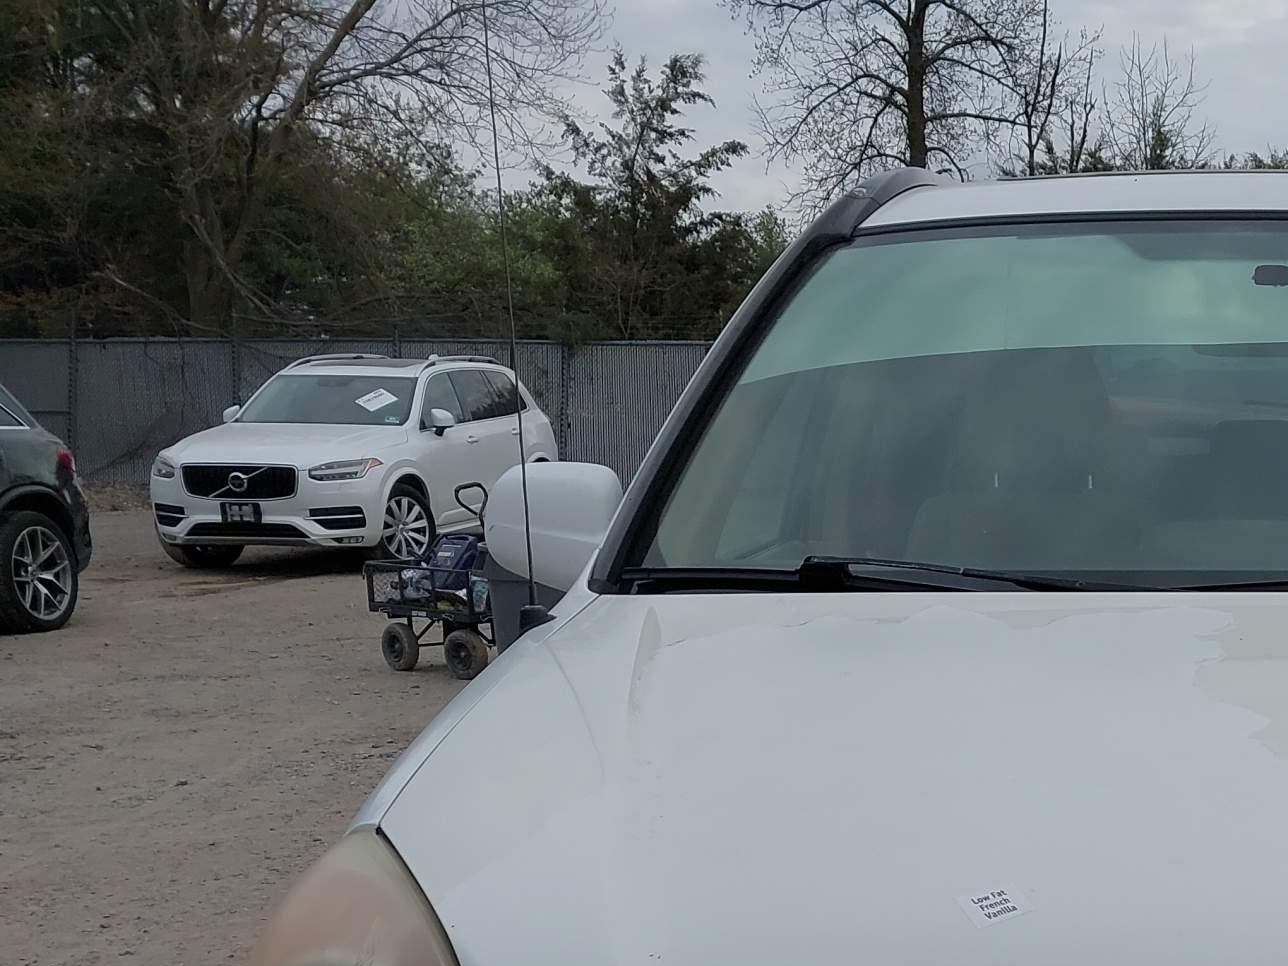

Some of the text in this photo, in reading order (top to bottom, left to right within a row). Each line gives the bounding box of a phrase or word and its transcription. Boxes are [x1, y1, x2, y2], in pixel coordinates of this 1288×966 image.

[970, 889, 1007, 905] Low Fat
[979, 897, 1011, 912] French
[984, 905, 1018, 920] Vanilla
